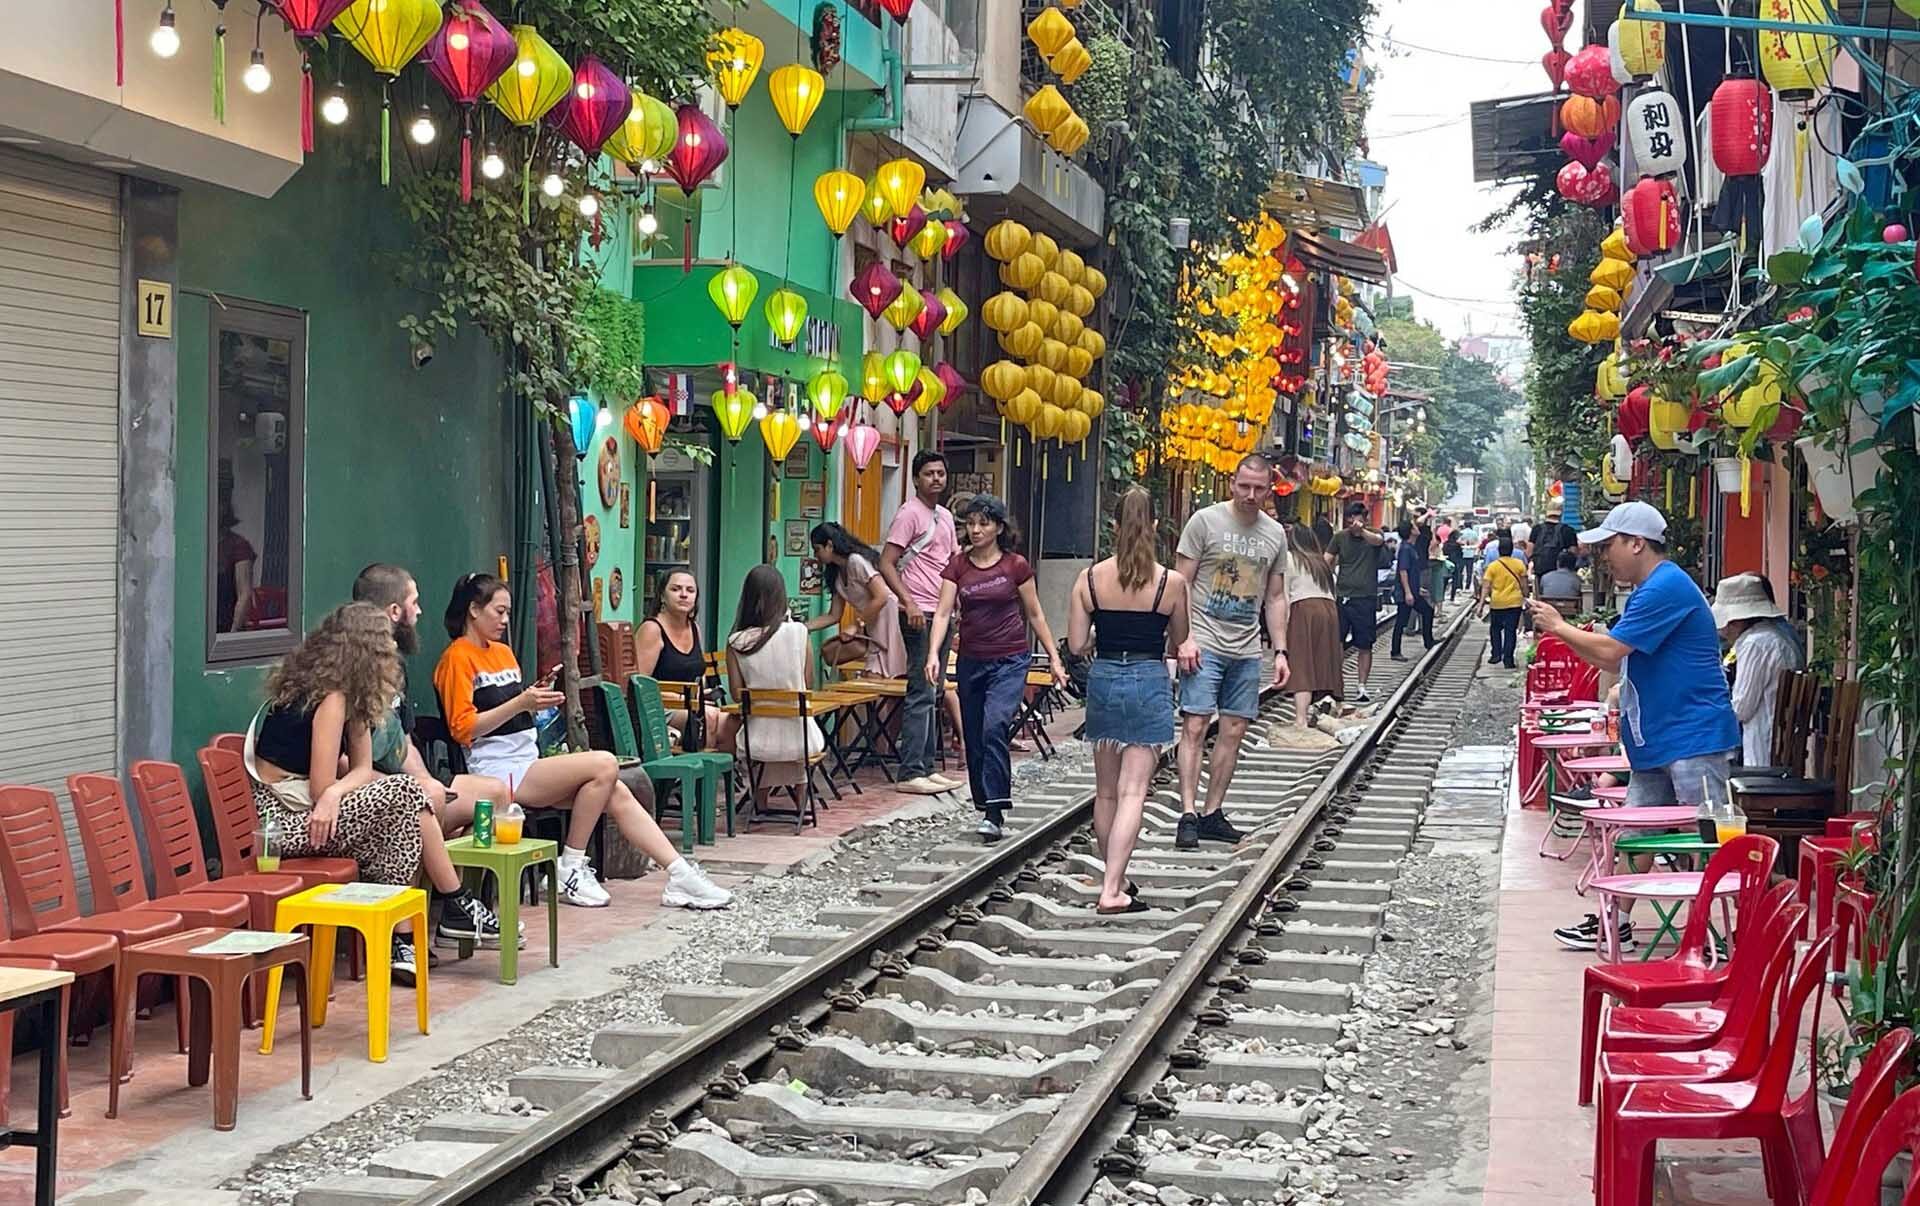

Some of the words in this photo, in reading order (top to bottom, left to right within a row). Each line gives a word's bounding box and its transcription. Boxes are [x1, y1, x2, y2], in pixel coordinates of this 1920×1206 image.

[145, 292, 165, 326] 17
[1223, 532, 1265, 547] BEACH
[1223, 543, 1256, 557] CLUB
[565, 868, 579, 897] LA
